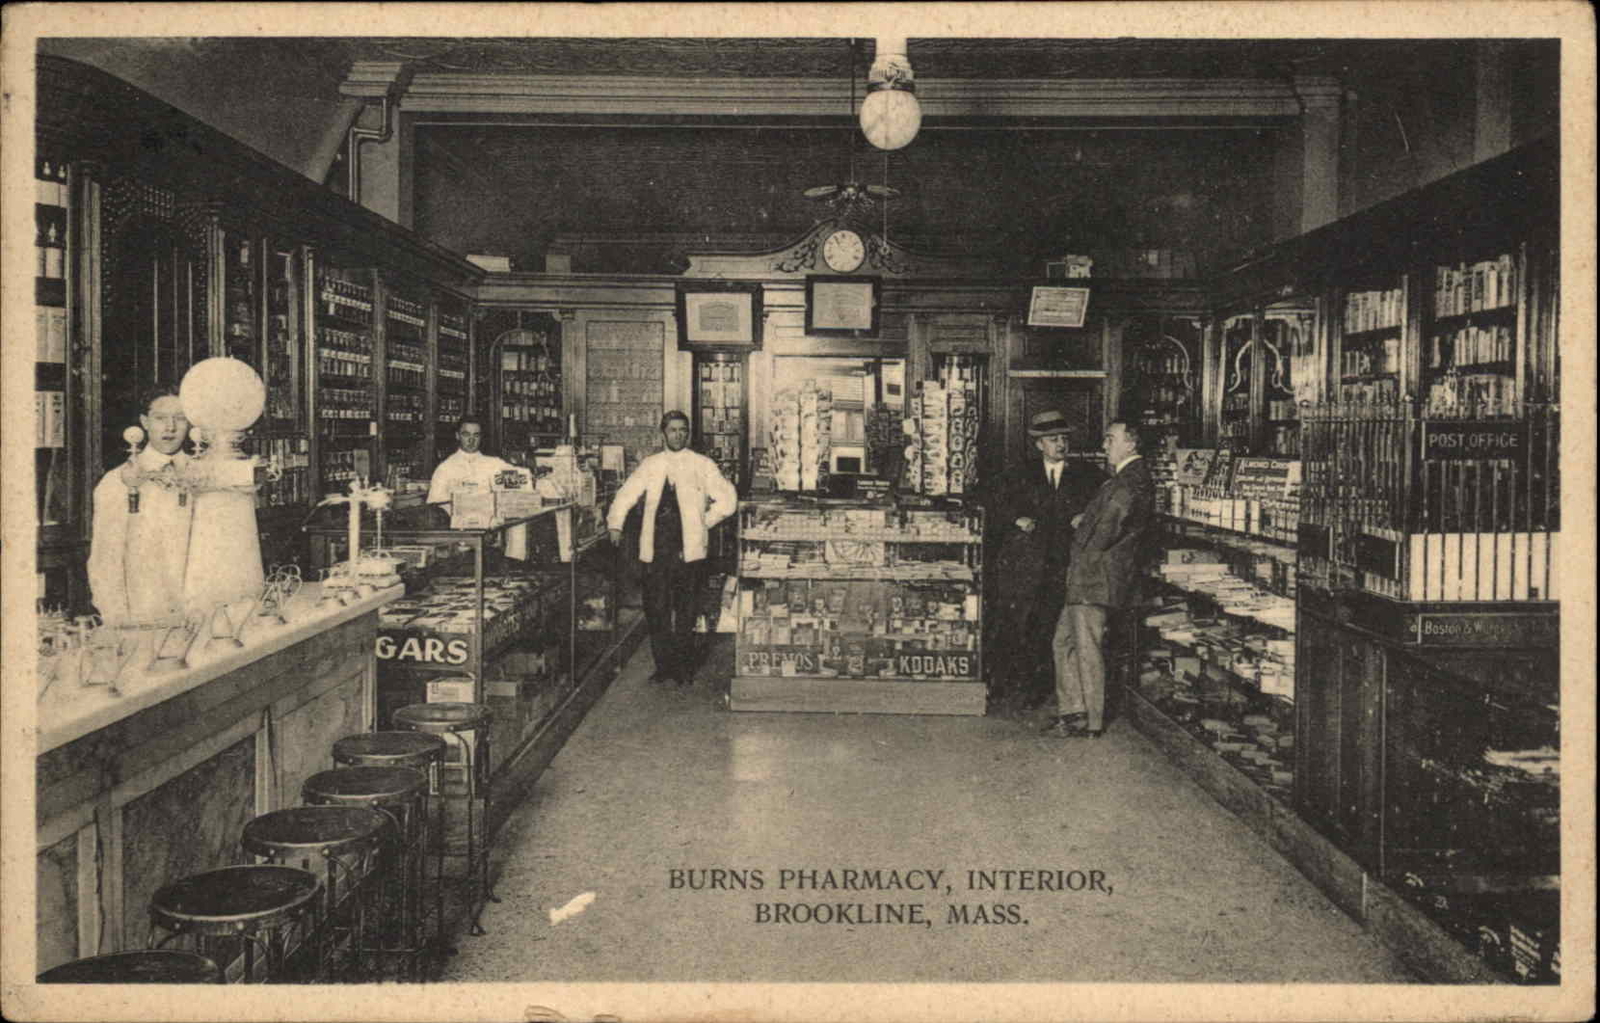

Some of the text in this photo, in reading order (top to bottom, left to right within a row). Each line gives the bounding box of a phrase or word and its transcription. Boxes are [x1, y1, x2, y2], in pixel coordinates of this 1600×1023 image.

[1428, 432, 1519, 448] POST OFFICE
[1424, 620, 1461, 635] Boston
[899, 655, 969, 674] KODAKS
